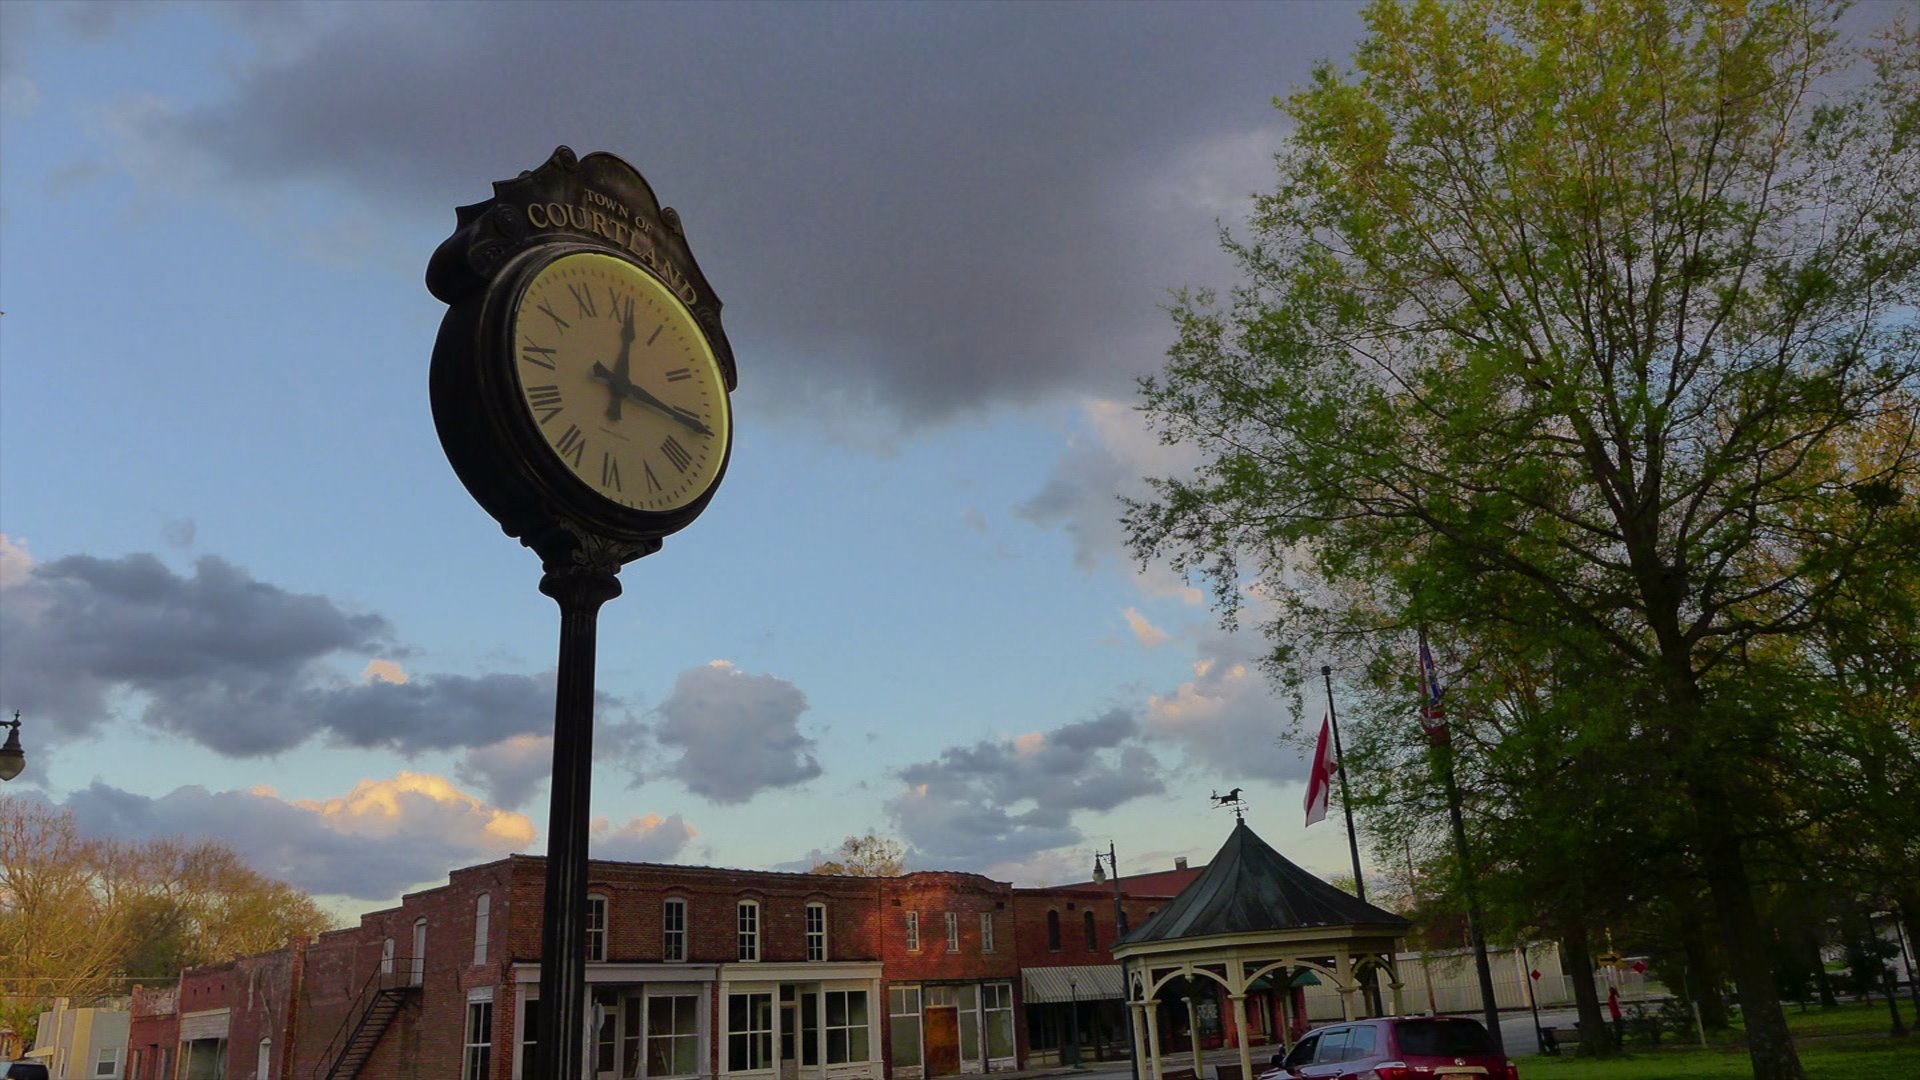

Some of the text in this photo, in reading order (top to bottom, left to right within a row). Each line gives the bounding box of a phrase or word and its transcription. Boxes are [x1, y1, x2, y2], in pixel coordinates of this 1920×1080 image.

[585, 188, 653, 232] TOWN OF
[528, 202, 698, 305] COURTLAND
[537, 298, 570, 336] X
[568, 282, 597, 318] XI
